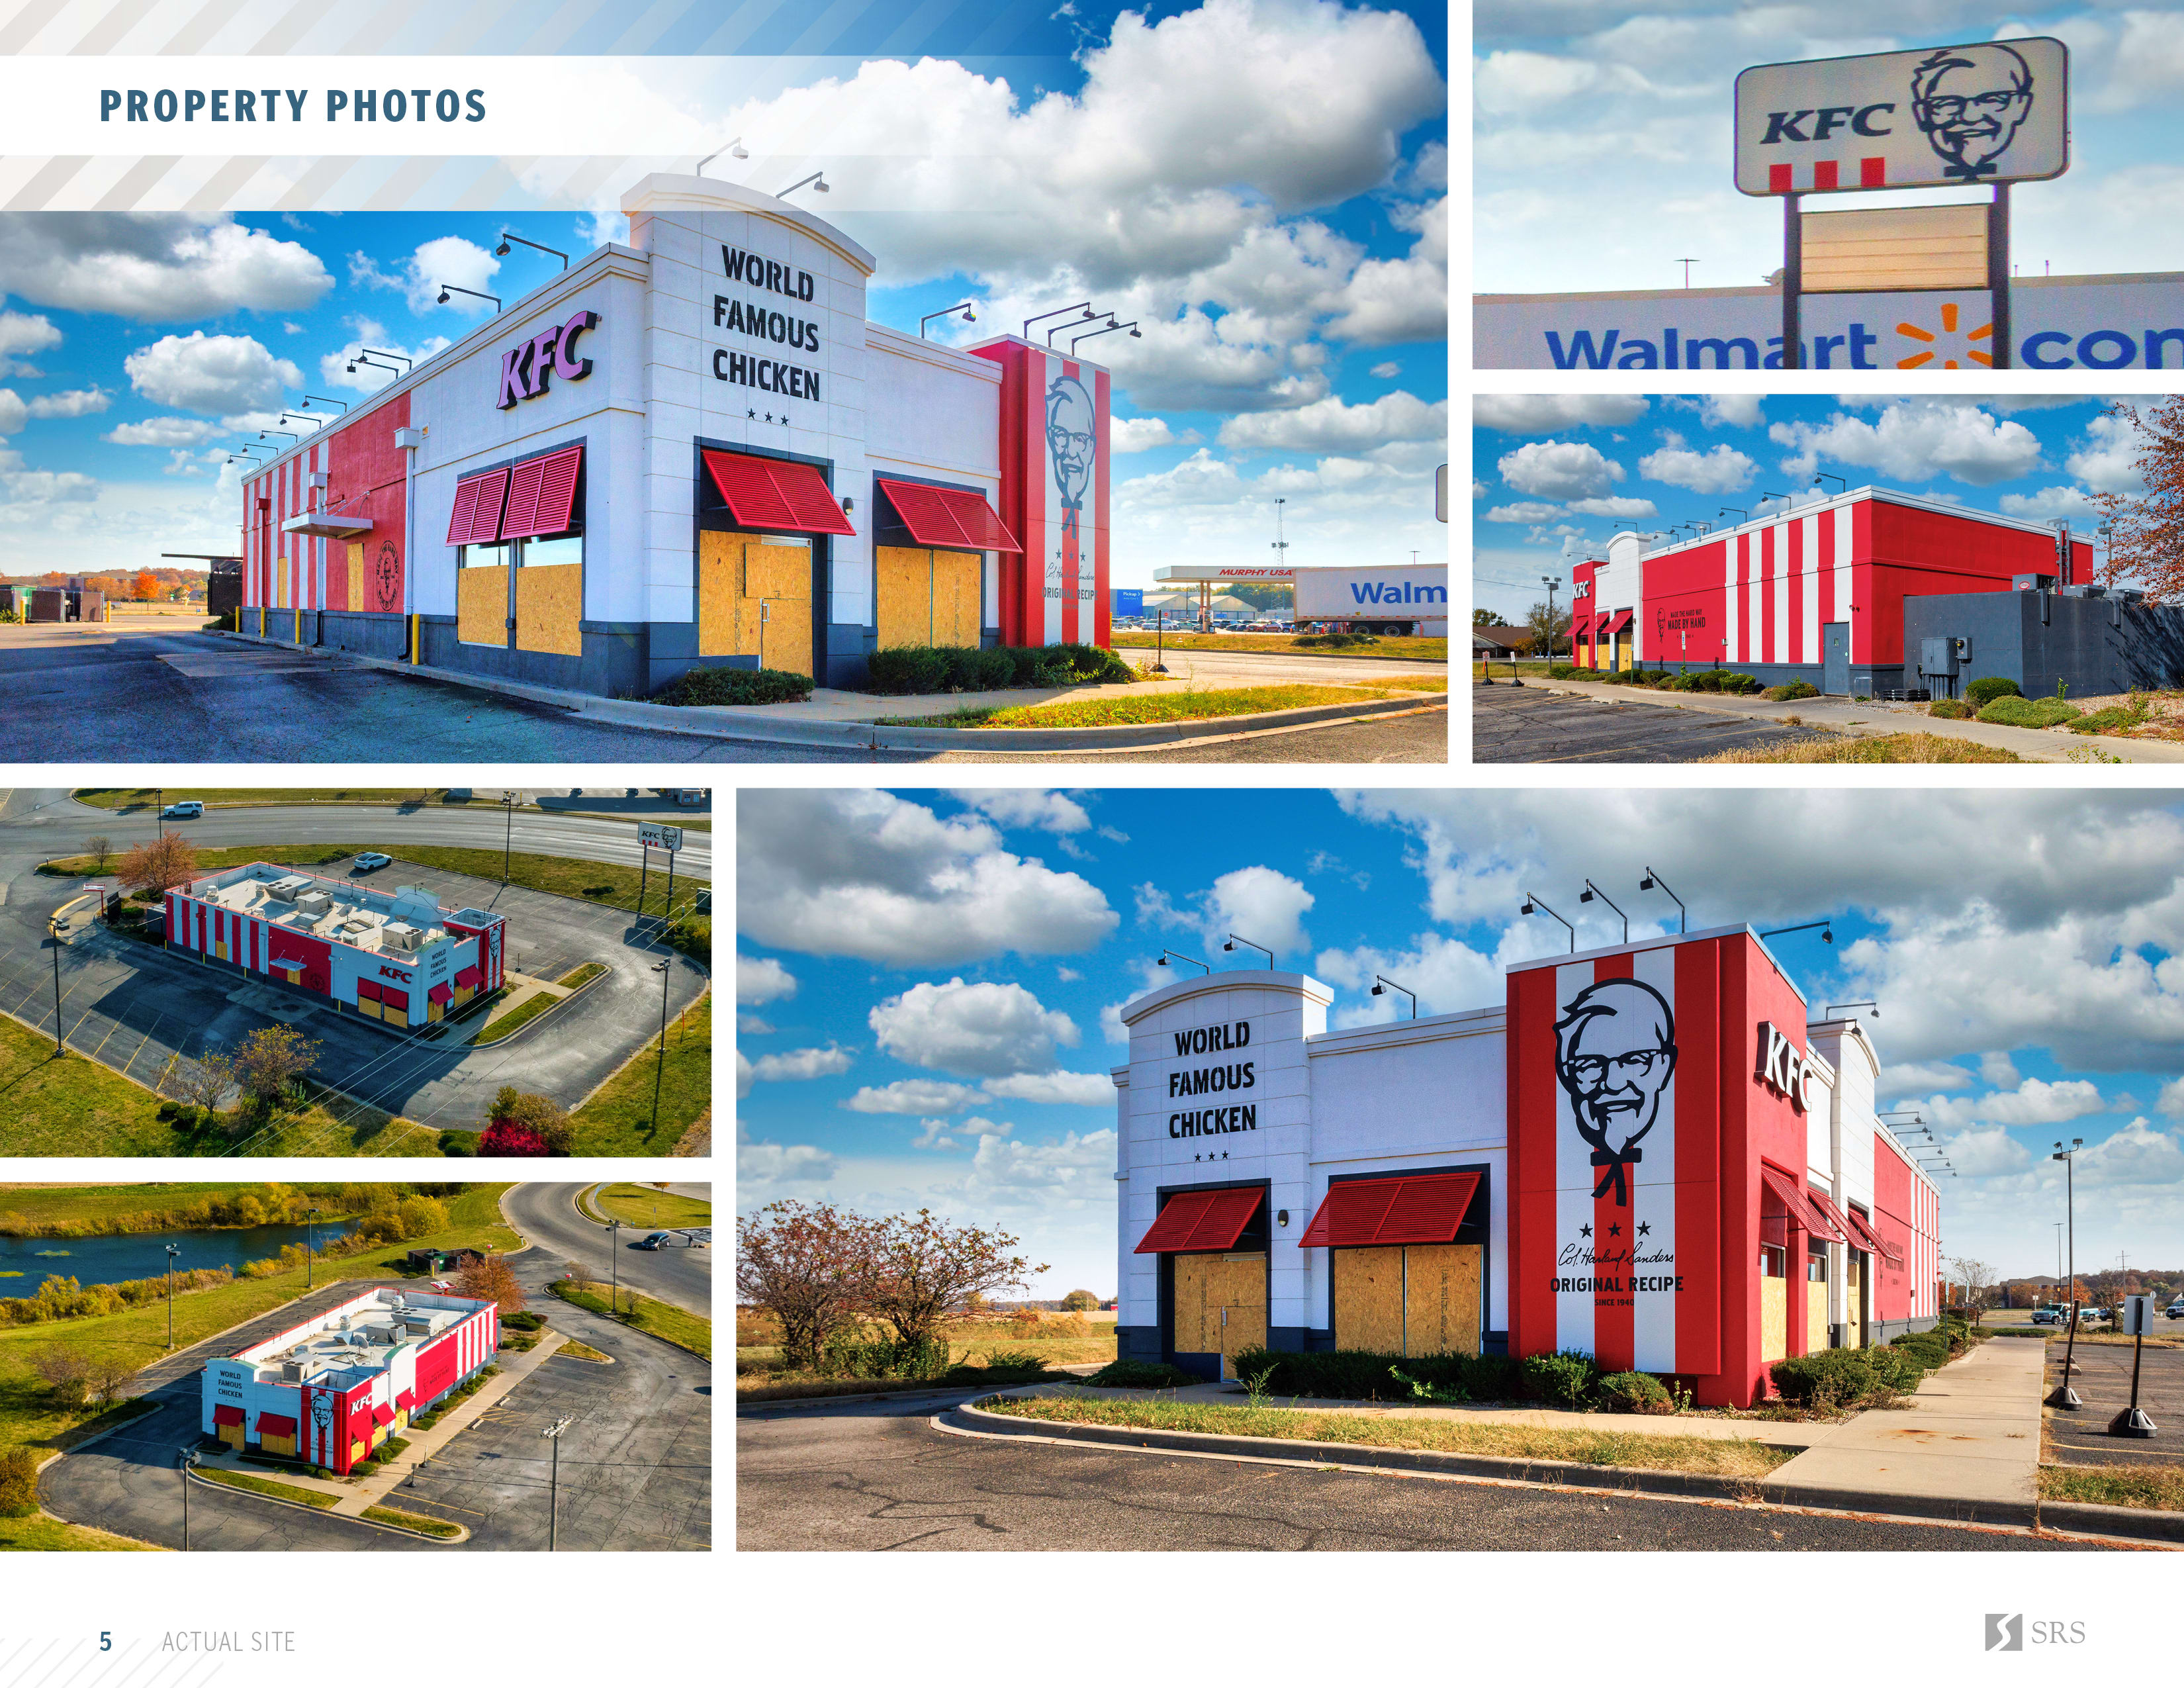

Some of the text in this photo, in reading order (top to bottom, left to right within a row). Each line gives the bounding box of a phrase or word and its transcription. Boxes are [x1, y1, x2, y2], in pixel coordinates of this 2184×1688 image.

[1760, 103, 1895, 144] KFC
[721, 244, 814, 302] WORLD
[714, 294, 819, 353] FAMOUS
[496, 310, 596, 410] KFC
[713, 348, 820, 402] CHICKEN
[1042, 587, 1099, 600] ORIGINAL RECIPE
[1350, 582, 1447, 604] Walm
[1572, 581, 1590, 600] KFC
[1668, 616, 1706, 630] MADE BY HAND
[641, 830, 660, 839] KFC
[430, 957, 447, 969] FAMOUS
[432, 949, 446, 961] WORLD
[378, 965, 413, 984] KFC
[430, 965, 447, 978] CHICKEN
[1175, 1021, 1250, 1056] WORLD
[1756, 1020, 1813, 1113] KFC
[1169, 1062, 1255, 1098] FAMOUS
[1169, 1104, 1256, 1139] CHICKEN
[1625, 1241, 1674, 1266] Sanders
[1550, 1276, 1684, 1292] ORIGINAL RECIPE
[218, 1379, 242, 1389] FAMOUS
[220, 1370, 241, 1380] WORLD
[218, 1388, 242, 1398] CHICKEN
[350, 1393, 372, 1416] KFC
